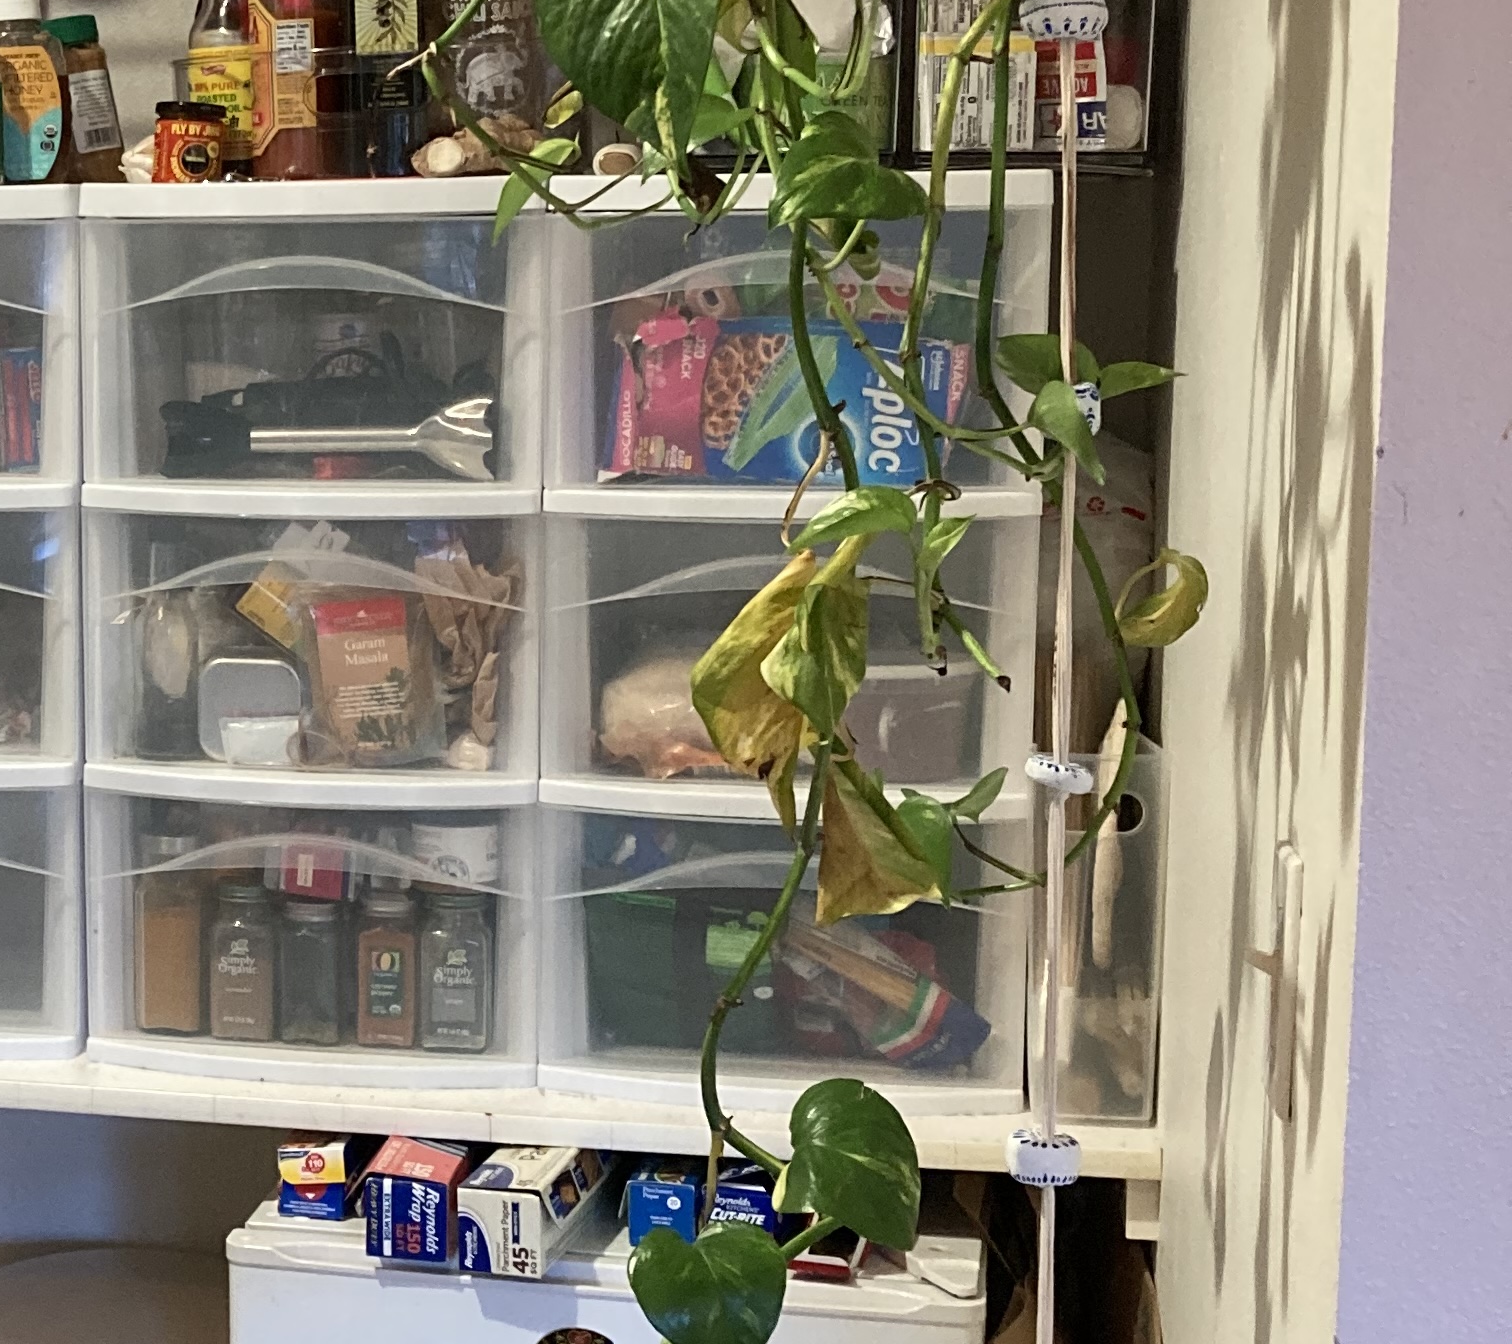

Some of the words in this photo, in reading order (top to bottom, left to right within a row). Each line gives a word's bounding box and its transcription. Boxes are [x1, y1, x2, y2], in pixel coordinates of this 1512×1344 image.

[212, 82, 239, 92] PURE
[171, 124, 187, 137] FLY
[188, 123, 202, 136] BY
[952, 348, 966, 401] SNACK
[620, 389, 631, 467] BOCADILLO
[344, 638, 386, 652] Garam
[345, 651, 388, 666] Masala
[220, 956, 256, 968] Simply
[218, 964, 257, 976] Organic
[437, 966, 473, 978] Simply
[433, 973, 475, 987] Organic
[408, 1182, 426, 1223] Wrap
[643, 1192, 660, 1200] Paper
[501, 1199, 510, 1226] Paper
[710, 1207, 766, 1226] CUT-RITE
[425, 1187, 441, 1255] Reynolds
[407, 1223, 422, 1254] 150
[464, 1230, 473, 1269] Reynolds
[501, 1226, 510, 1273] Parchment
[530, 1248, 538, 1262] FT
[513, 1247, 530, 1274] 45
[530, 1261, 538, 1275] SQ
